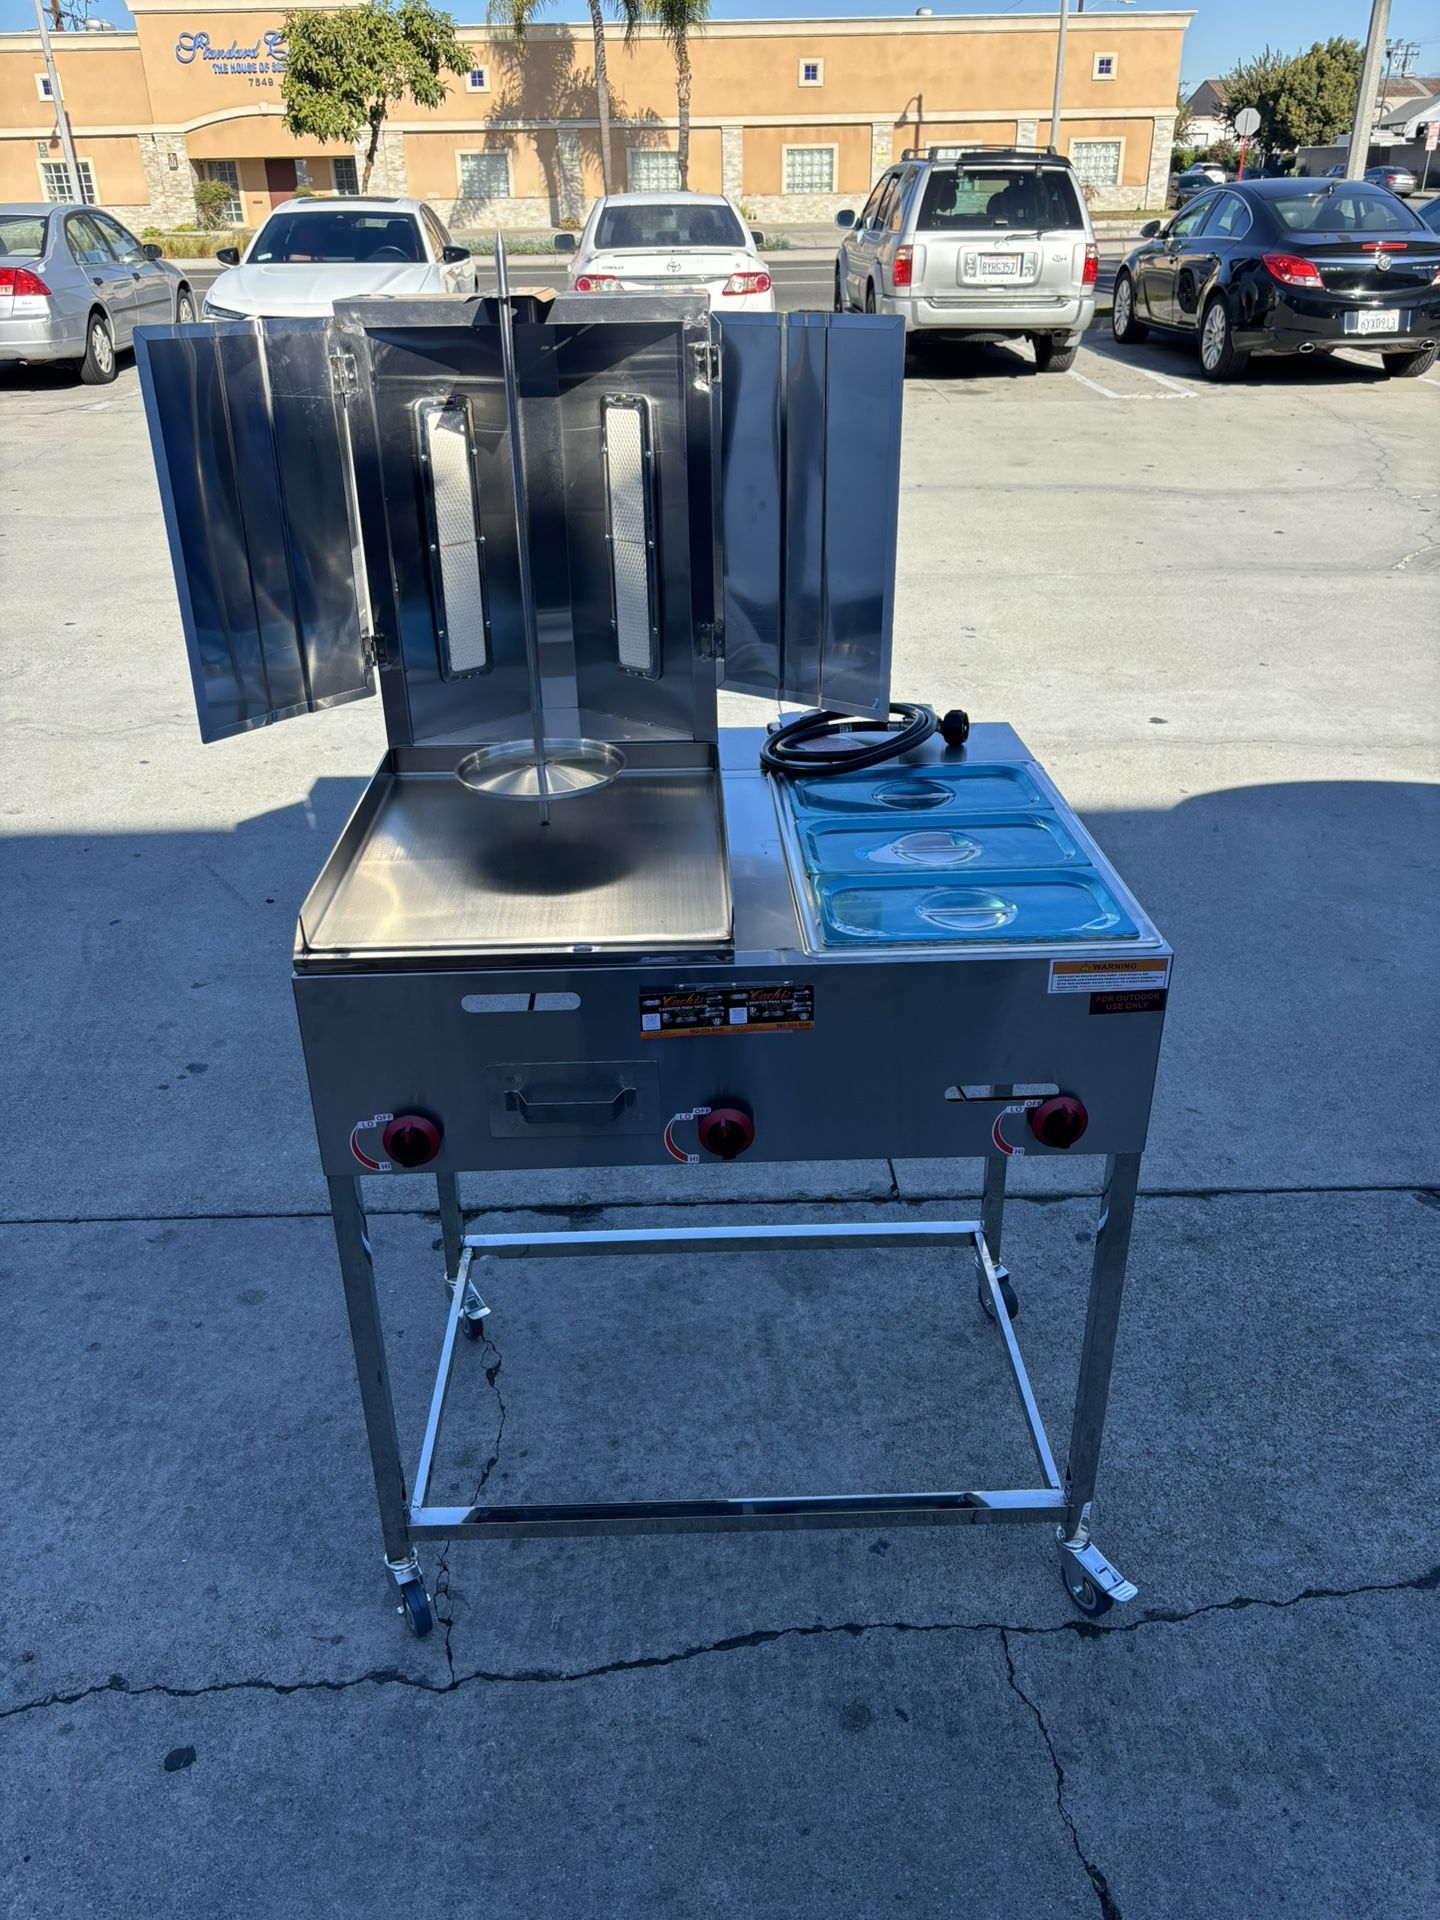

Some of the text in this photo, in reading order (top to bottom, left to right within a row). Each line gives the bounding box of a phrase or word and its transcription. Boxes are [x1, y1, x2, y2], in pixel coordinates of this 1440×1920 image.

[176, 31, 261, 63] Standard
[212, 62, 229, 74] THE
[230, 61, 257, 74] HOUSE
[259, 61, 270, 73] OF
[248, 77, 274, 87] 7549
[1093, 962, 1138, 971] WARNING
[1096, 992, 1160, 1003] FOR OUTDOOR
[1106, 1001, 1149, 1010] USE ONLY
[376, 1113, 393, 1121] OFF
